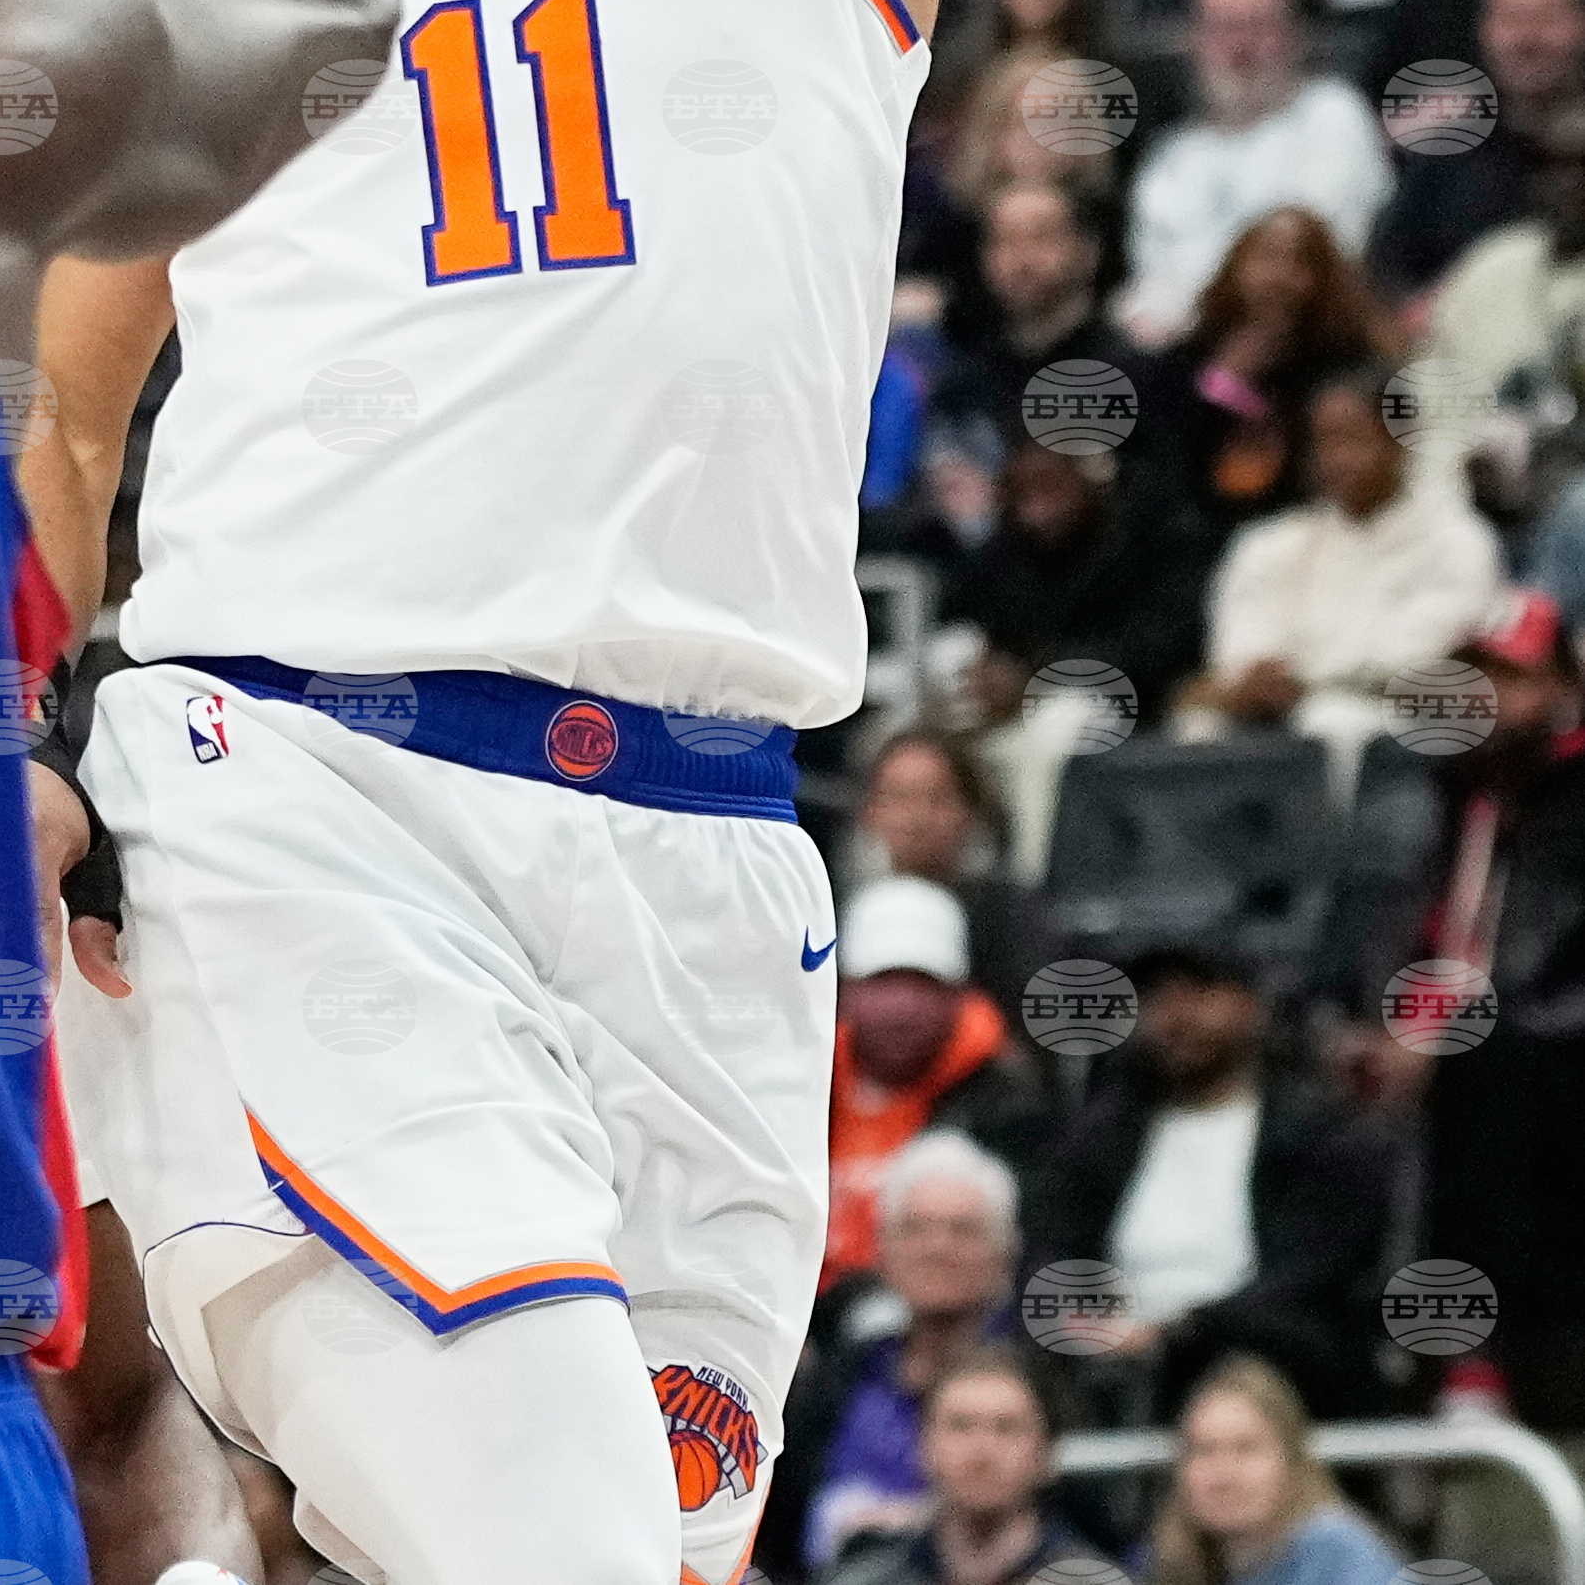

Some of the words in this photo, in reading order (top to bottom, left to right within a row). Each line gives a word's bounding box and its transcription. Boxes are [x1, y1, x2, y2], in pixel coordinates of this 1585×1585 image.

[652, 1365, 759, 1492] KNICKS
[696, 1366, 725, 1387] NEW
[725, 1377, 749, 1411] YORK
